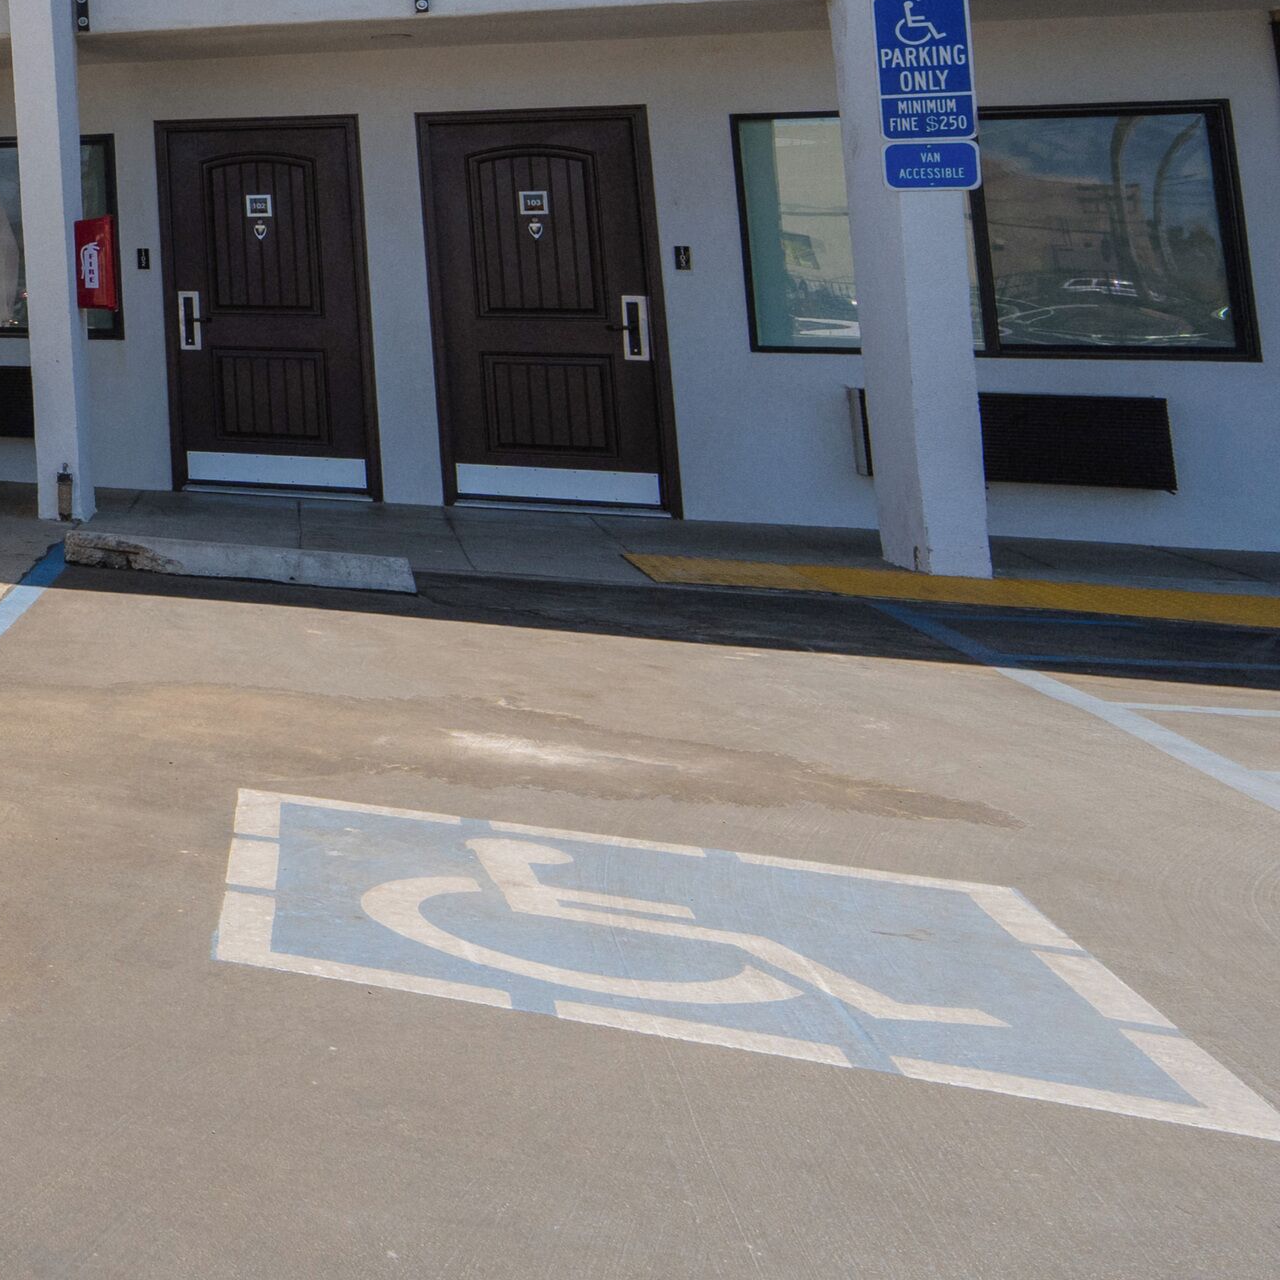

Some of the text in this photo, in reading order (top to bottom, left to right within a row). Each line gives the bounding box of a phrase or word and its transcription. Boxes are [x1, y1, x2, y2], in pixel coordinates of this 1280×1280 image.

[880, 44, 966, 69] PARKING
[900, 69, 949, 92] ONLY
[897, 98, 957, 115] MINIMUM
[889, 114, 967, 132] FINE $250
[920, 152, 941, 163] VAN
[899, 167, 965, 179] ACCESSIBLE
[88, 253, 96, 283] FIRE
